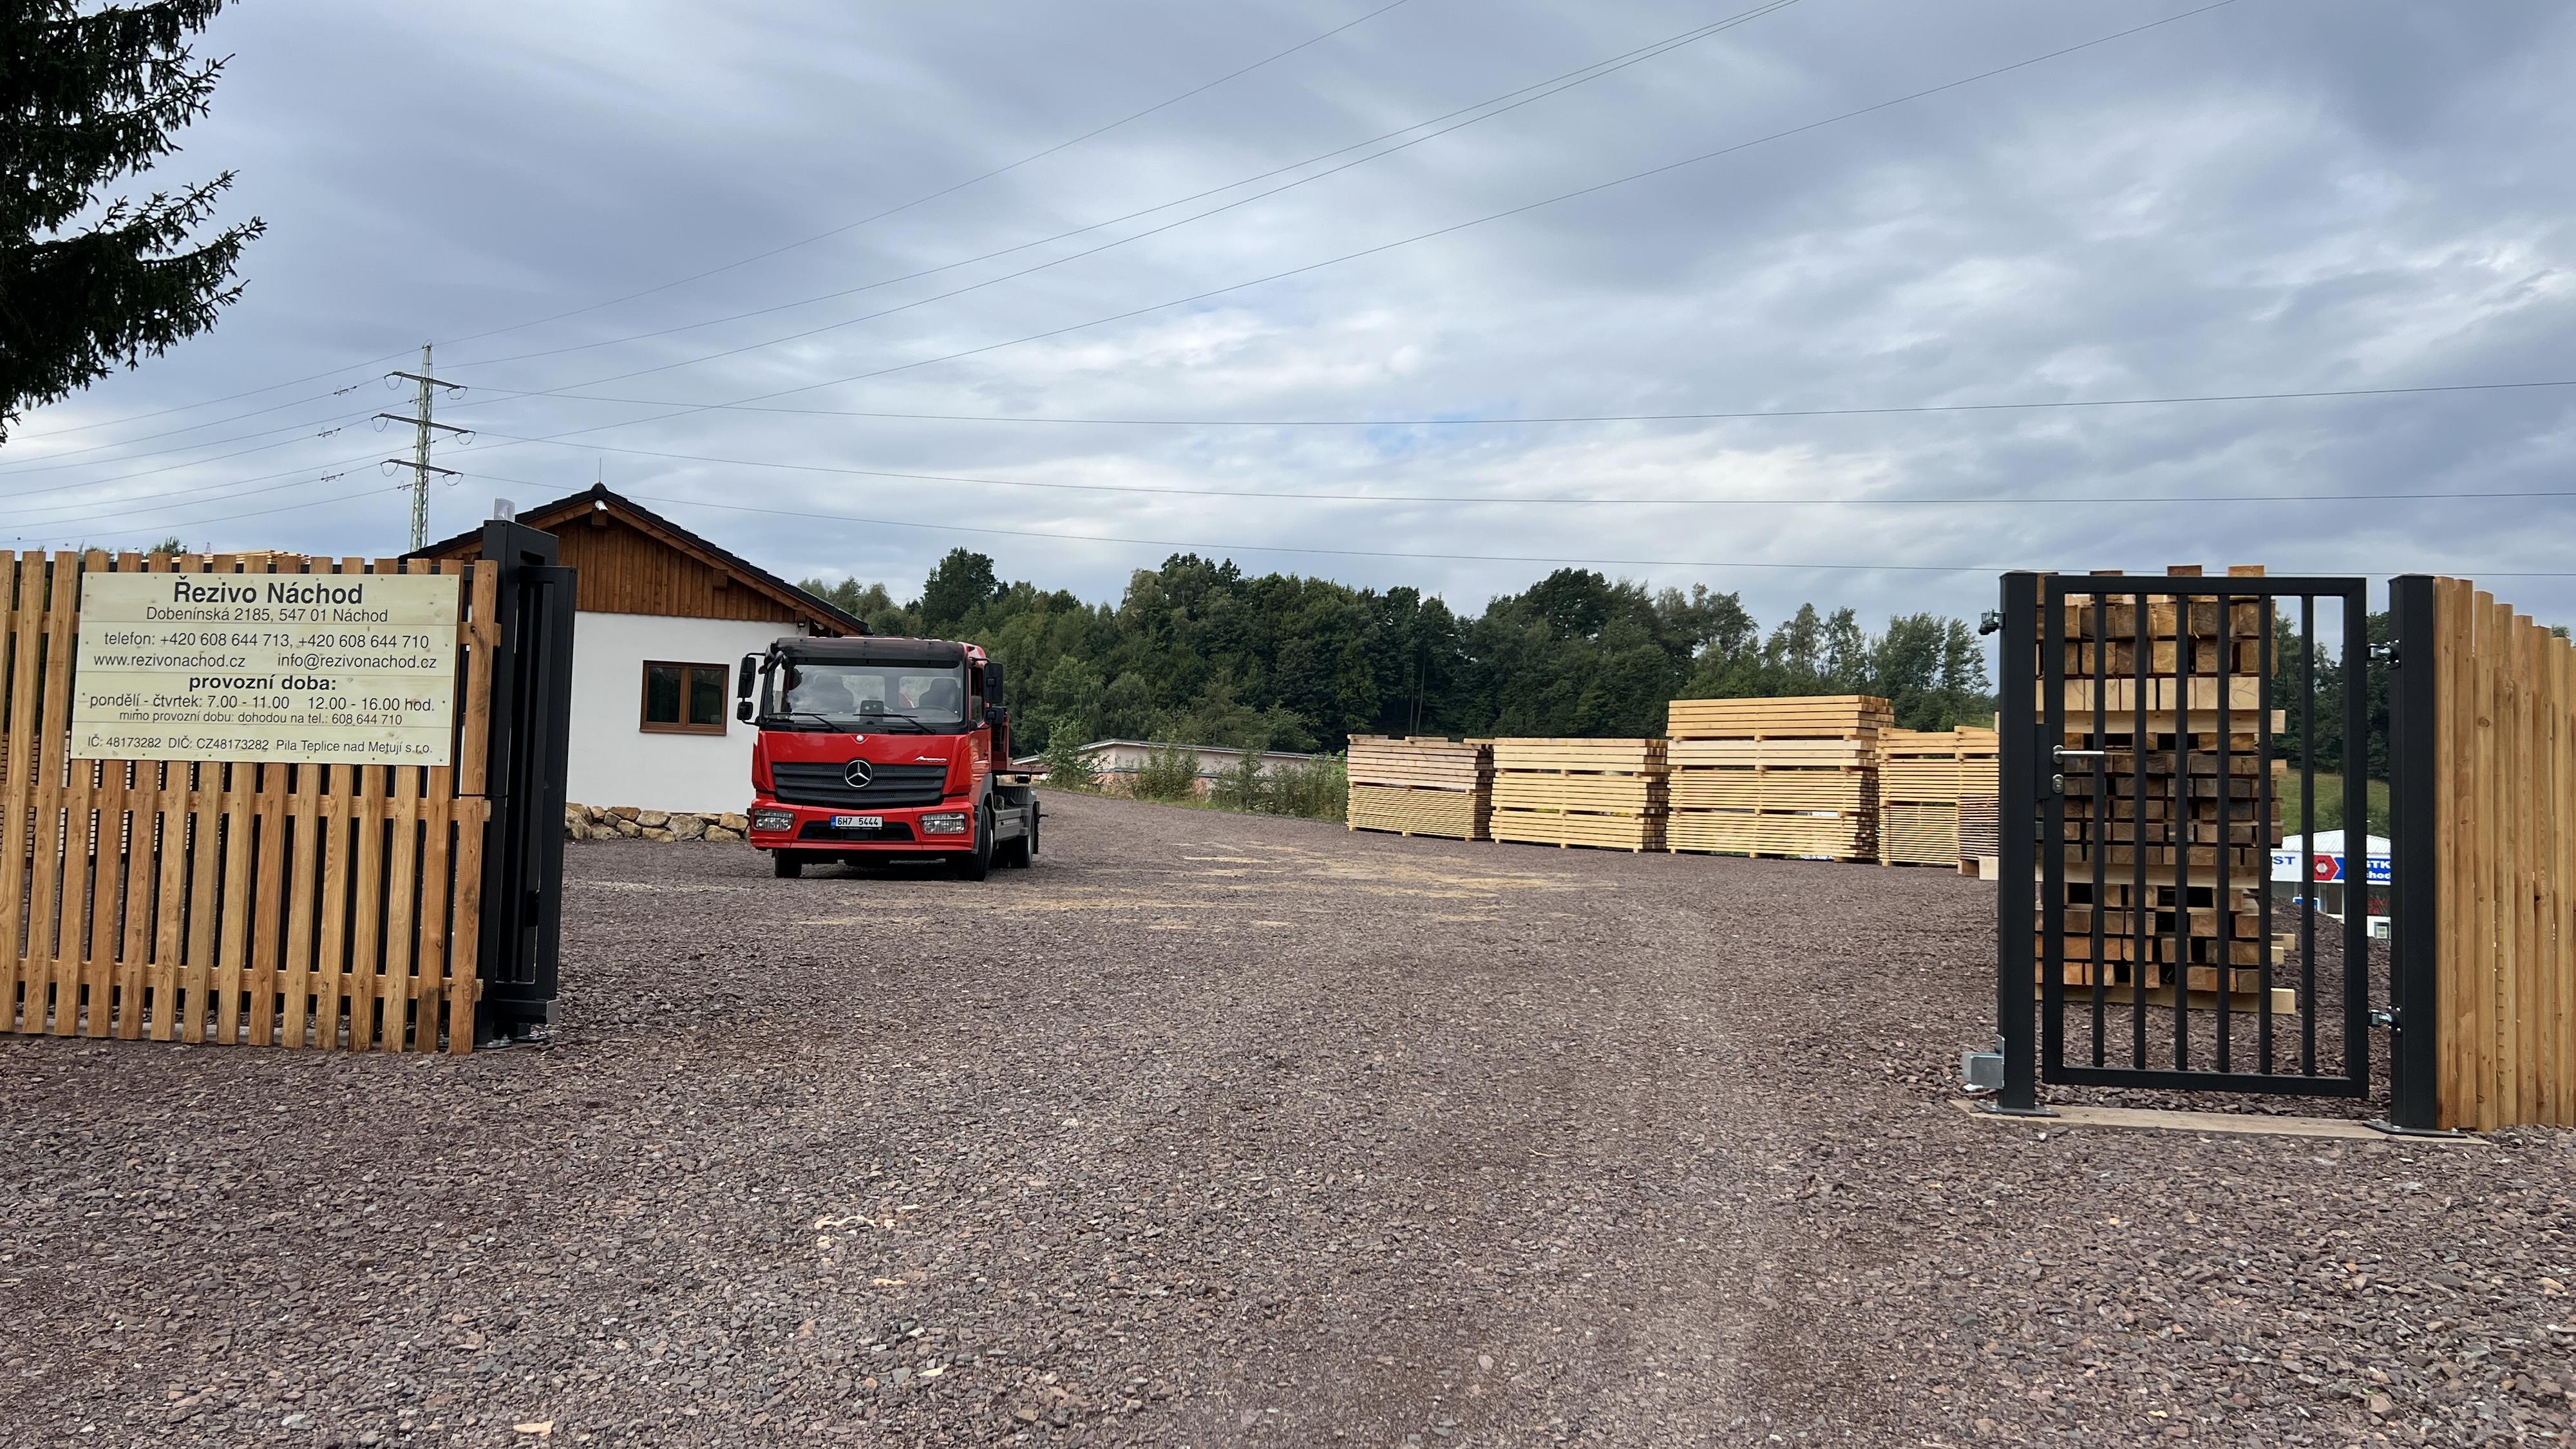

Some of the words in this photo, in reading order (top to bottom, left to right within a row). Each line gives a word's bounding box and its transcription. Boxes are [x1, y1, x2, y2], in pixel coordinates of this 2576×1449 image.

[174, 576, 256, 603] Řezivo
[267, 582, 363, 604] Náchod
[147, 607, 229, 620] Dobenínská
[234, 608, 273, 623] 2185,
[279, 609, 306, 621] 547
[311, 609, 325, 621] 01
[334, 609, 388, 622] Náchod
[105, 632, 155, 645] telefon:
[160, 633, 195, 645] +420
[201, 633, 226, 646] 608
[232, 634, 258, 646] 644
[263, 634, 292, 649] 713,
[297, 634, 334, 648] +420
[339, 635, 365, 647] 608
[371, 635, 397, 647] 644
[402, 636, 428, 649] 710
[94, 654, 245, 667] www.rezivonachod.cz
[278, 654, 437, 670] info@rezivonachod.cz
[189, 674, 276, 692] provozní
[281, 675, 336, 690] doba:
[90, 694, 140, 708] pondělí
[153, 694, 202, 707] čtvrtek:
[208, 696, 237, 708] 7.00
[253, 696, 289, 708] 11.00
[308, 697, 346, 710] 12.00
[362, 697, 399, 710] 16.00
[405, 698, 434, 711] hod.
[120, 712, 149, 720] mimo
[153, 711, 200, 723] provozní
[204, 712, 234, 722] dobu:
[238, 712, 287, 723] dohodou
[308, 714, 328, 723] tel.:
[332, 714, 352, 724] 608
[357, 714, 377, 724] 644
[381, 715, 402, 724] 710
[88, 734, 102, 746] IČ:
[106, 737, 161, 748] 48173282
[169, 735, 192, 748] DIČ:
[197, 738, 269, 750] CZ48173282
[276, 740, 296, 750] Pila
[301, 741, 339, 753] Teplice
[344, 742, 365, 752] nad
[368, 741, 402, 755] Metují
[406, 745, 431, 754] s.r.o.
[838, 817, 853, 826] 6H7
[858, 817, 878, 826] 5444
